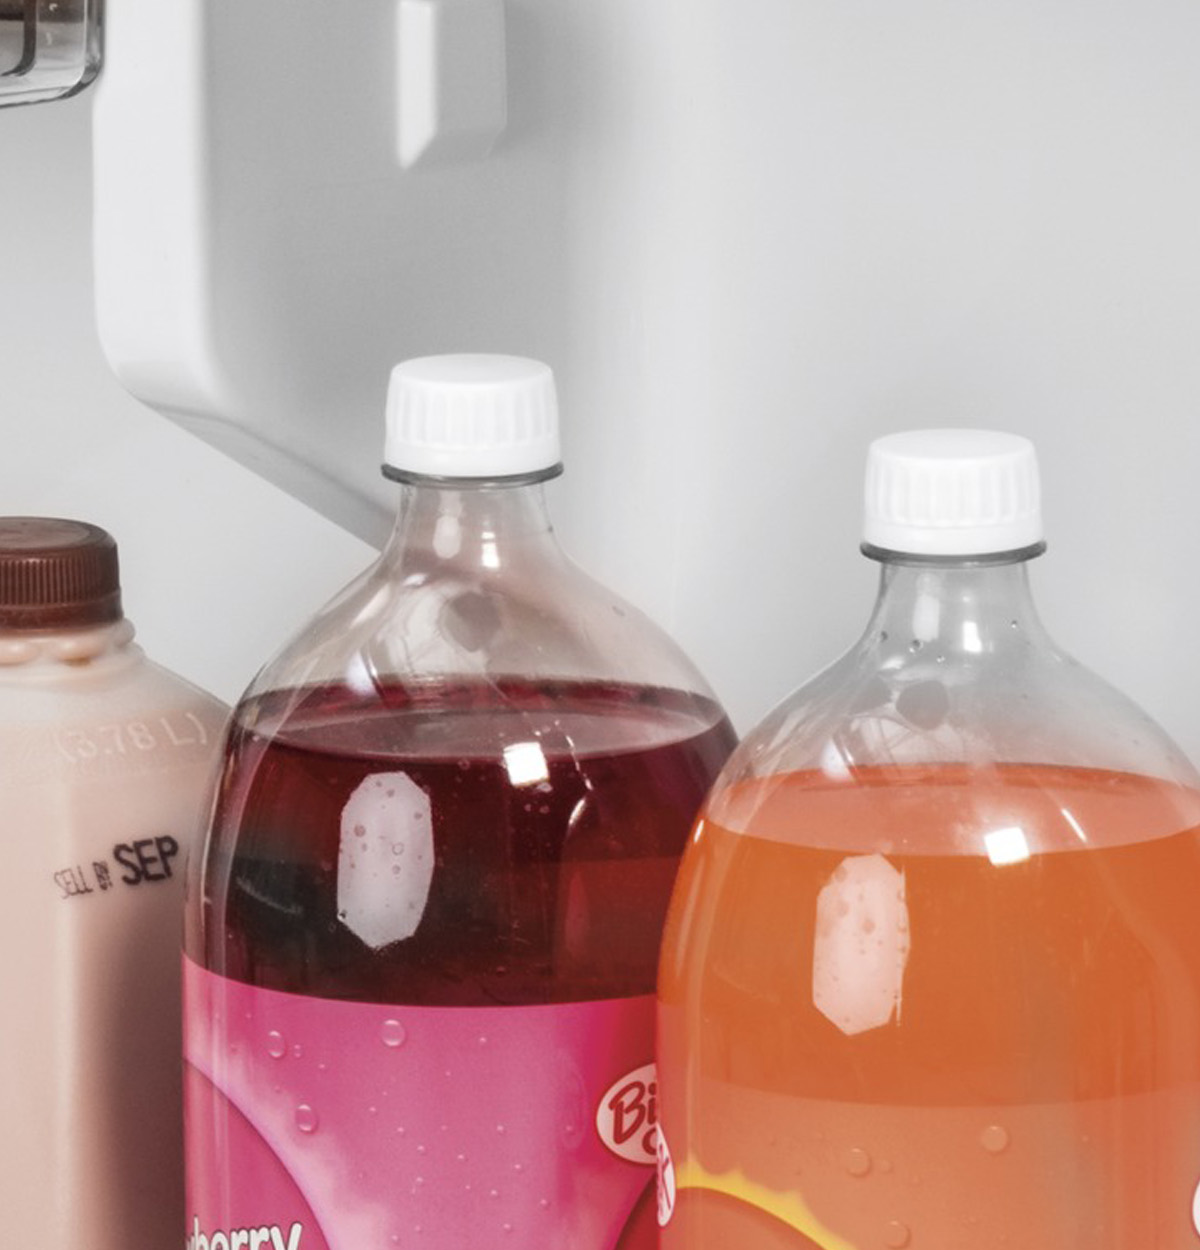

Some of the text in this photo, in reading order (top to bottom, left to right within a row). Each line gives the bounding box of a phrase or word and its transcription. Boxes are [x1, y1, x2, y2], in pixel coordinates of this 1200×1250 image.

[160, 711, 208, 746] L)
[113, 835, 179, 886] SEP
[608, 1080, 657, 1156] Bi
